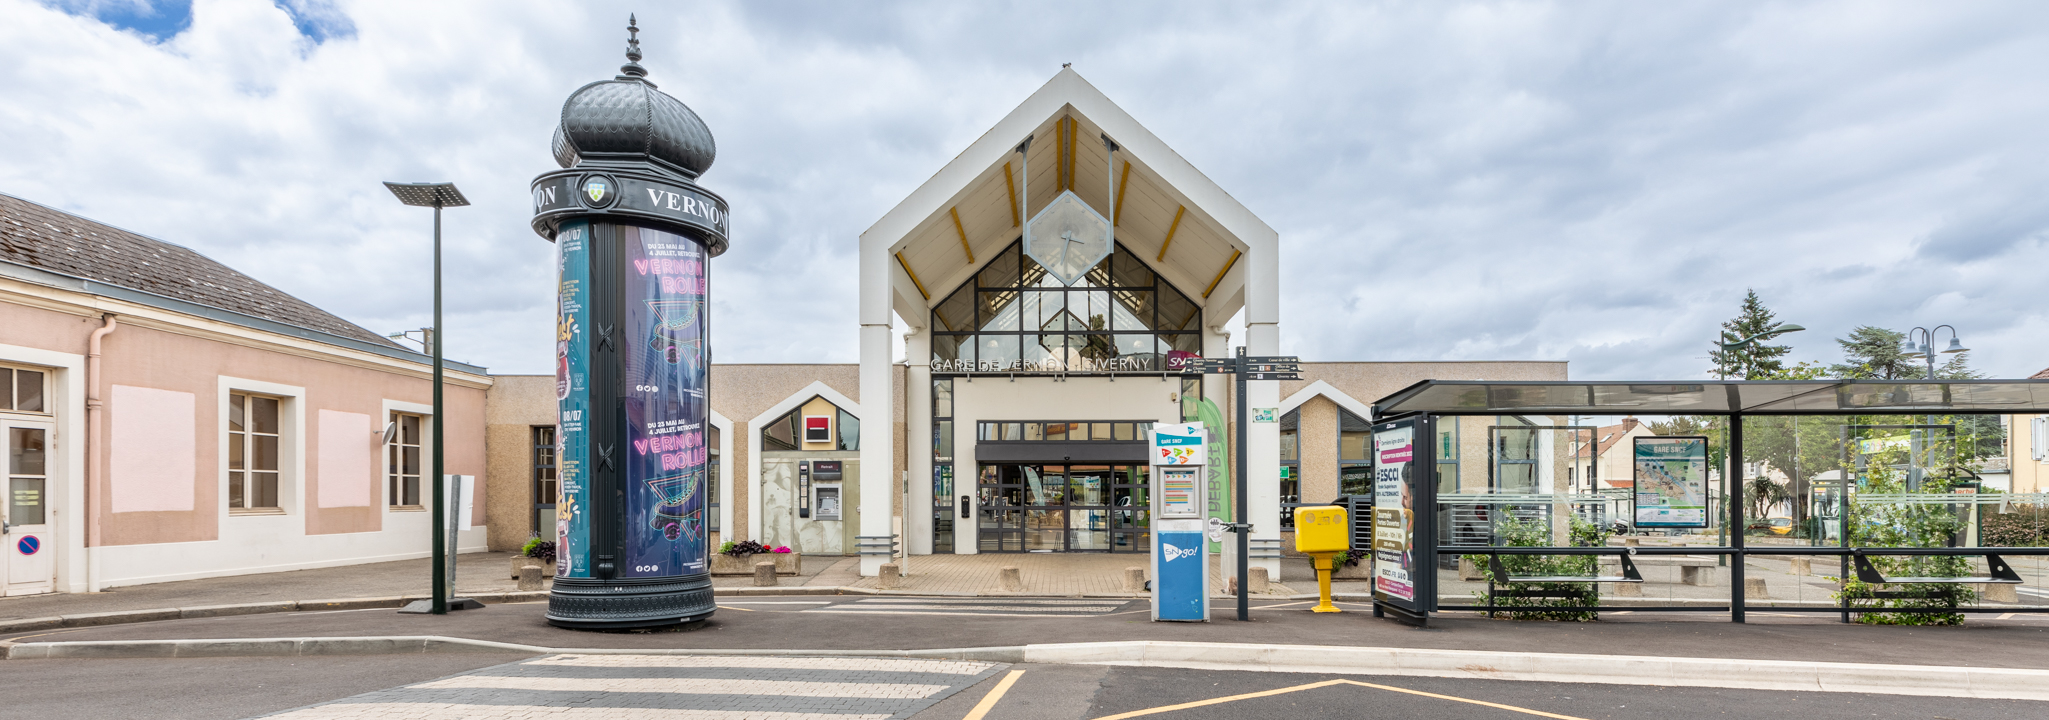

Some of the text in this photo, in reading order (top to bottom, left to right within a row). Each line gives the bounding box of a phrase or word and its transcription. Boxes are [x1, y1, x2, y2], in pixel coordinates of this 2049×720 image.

[646, 188, 726, 230] VERNON
[634, 258, 703, 277] VERNON
[930, 358, 974, 370] GARE
[978, 358, 1000, 370] DE
[1000, 357, 1069, 370] VERNON
[1081, 357, 1150, 370] GIVERNY
[563, 411, 582, 422] 08/07
[655, 426, 676, 434] JUILLET,
[677, 423, 700, 432] RETROUVEZ
[634, 431, 703, 456] VERNON
[1653, 445, 1670, 453] GARE
